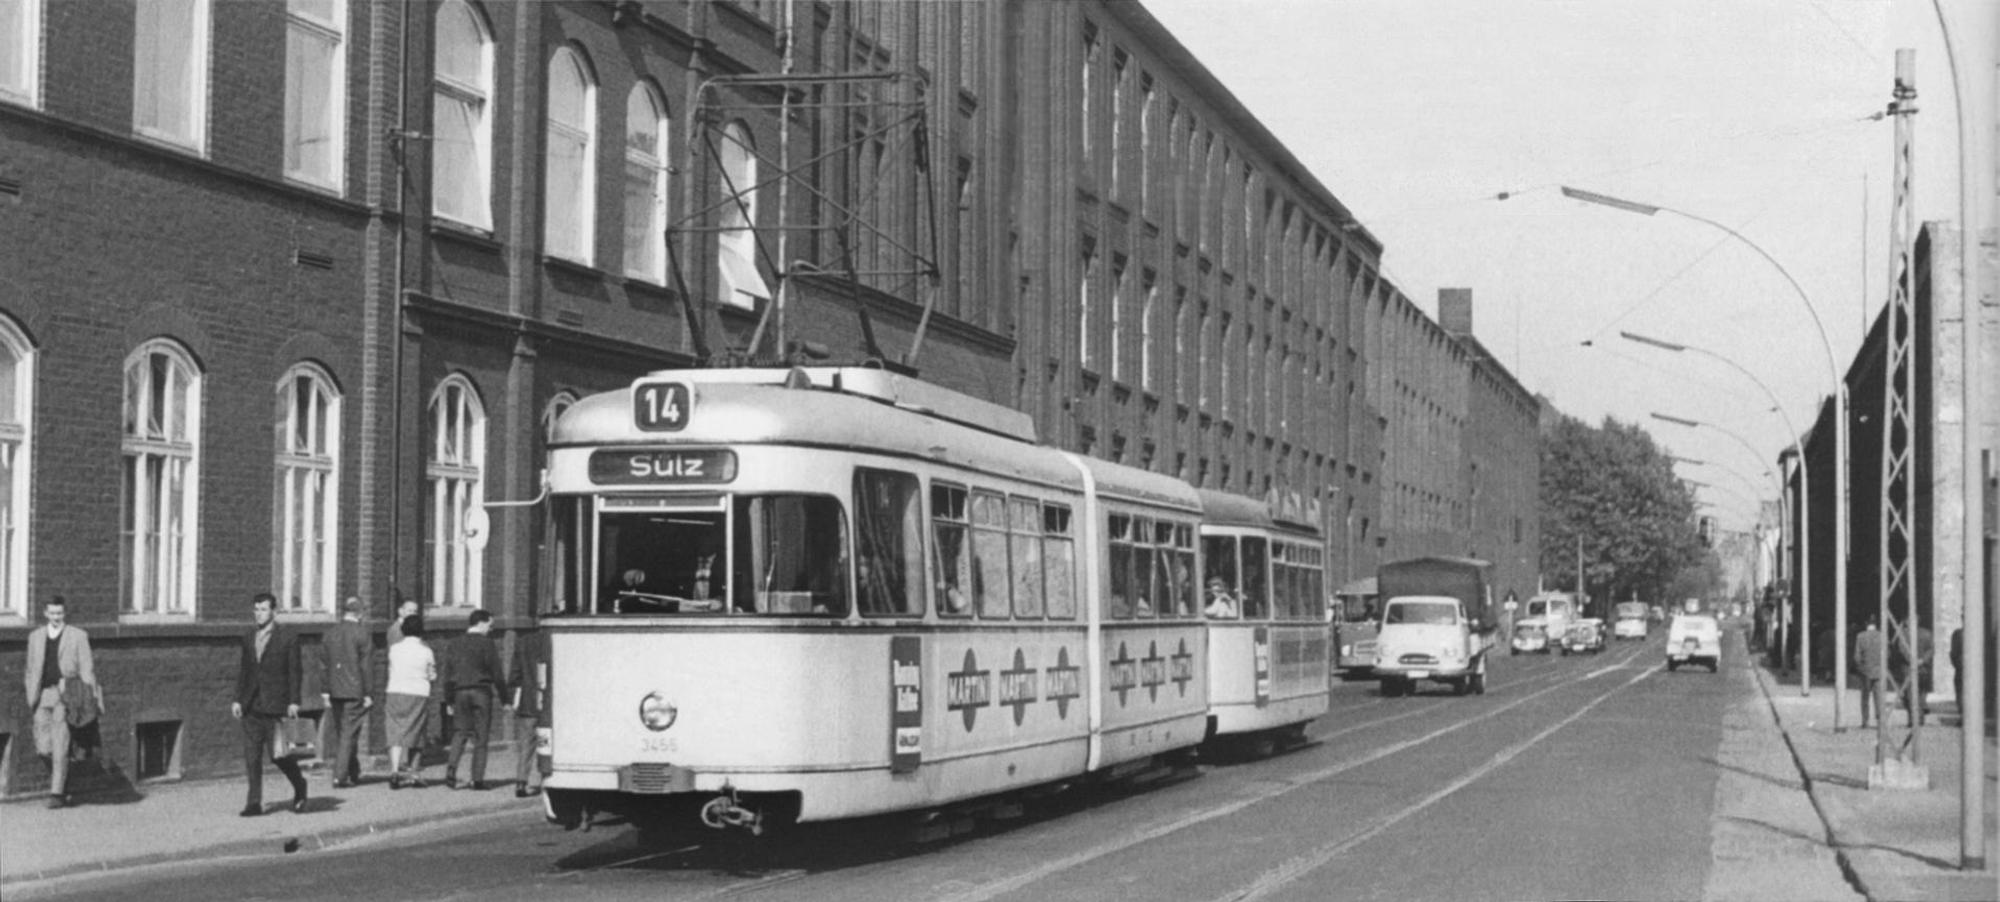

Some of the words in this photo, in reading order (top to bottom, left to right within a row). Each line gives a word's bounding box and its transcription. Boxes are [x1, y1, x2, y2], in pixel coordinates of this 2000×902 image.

[645, 387, 680, 424] 14
[629, 453, 704, 478] Sülz
[948, 674, 989, 706] MARTINI
